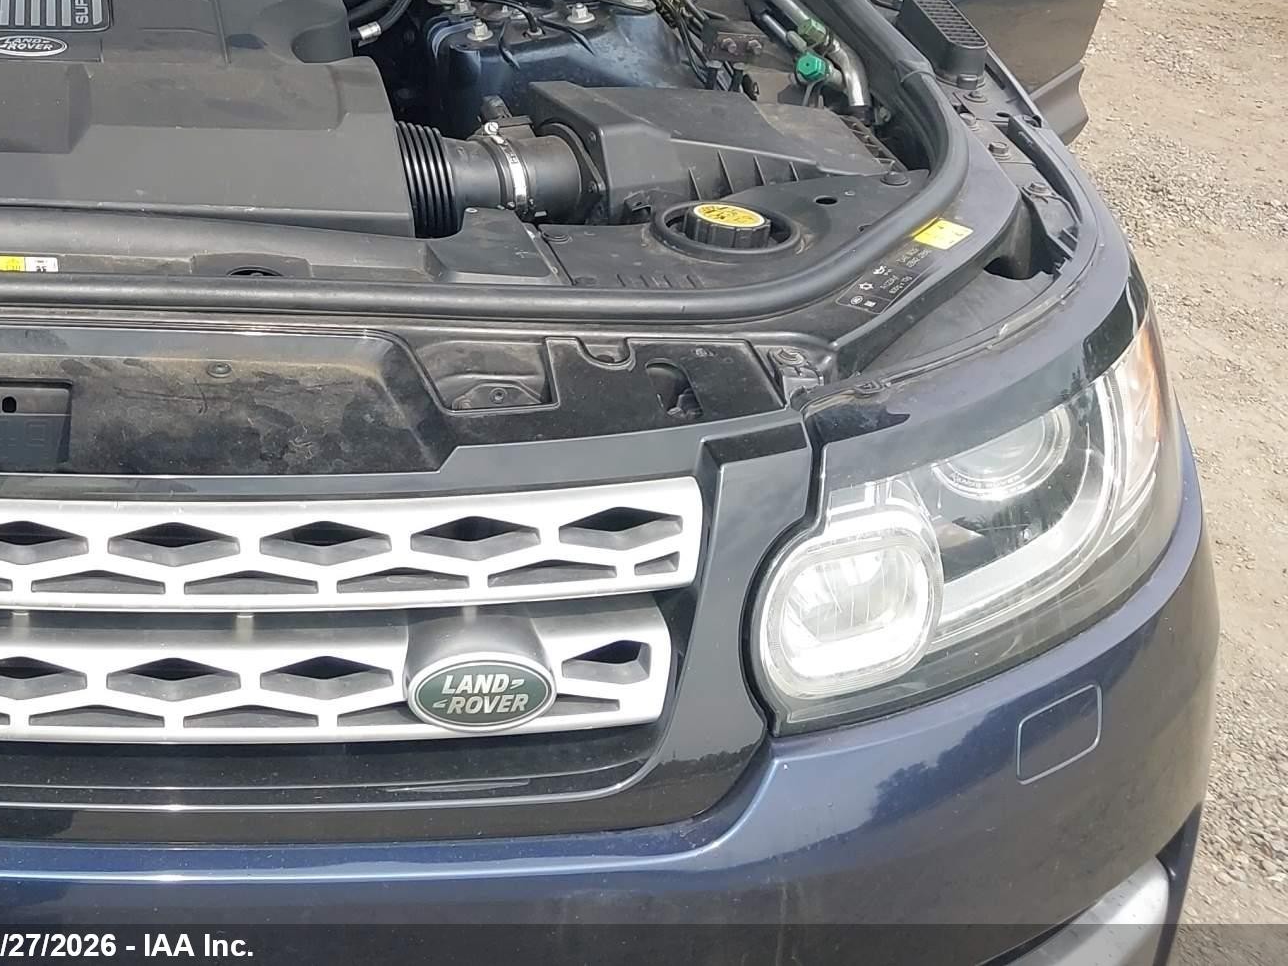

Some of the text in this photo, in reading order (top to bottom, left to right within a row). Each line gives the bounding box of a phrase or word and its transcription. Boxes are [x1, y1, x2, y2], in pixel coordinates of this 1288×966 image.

[6, 43, 54, 51] ROVER
[442, 673, 511, 695] LAND
[447, 693, 529, 715] ROVER
